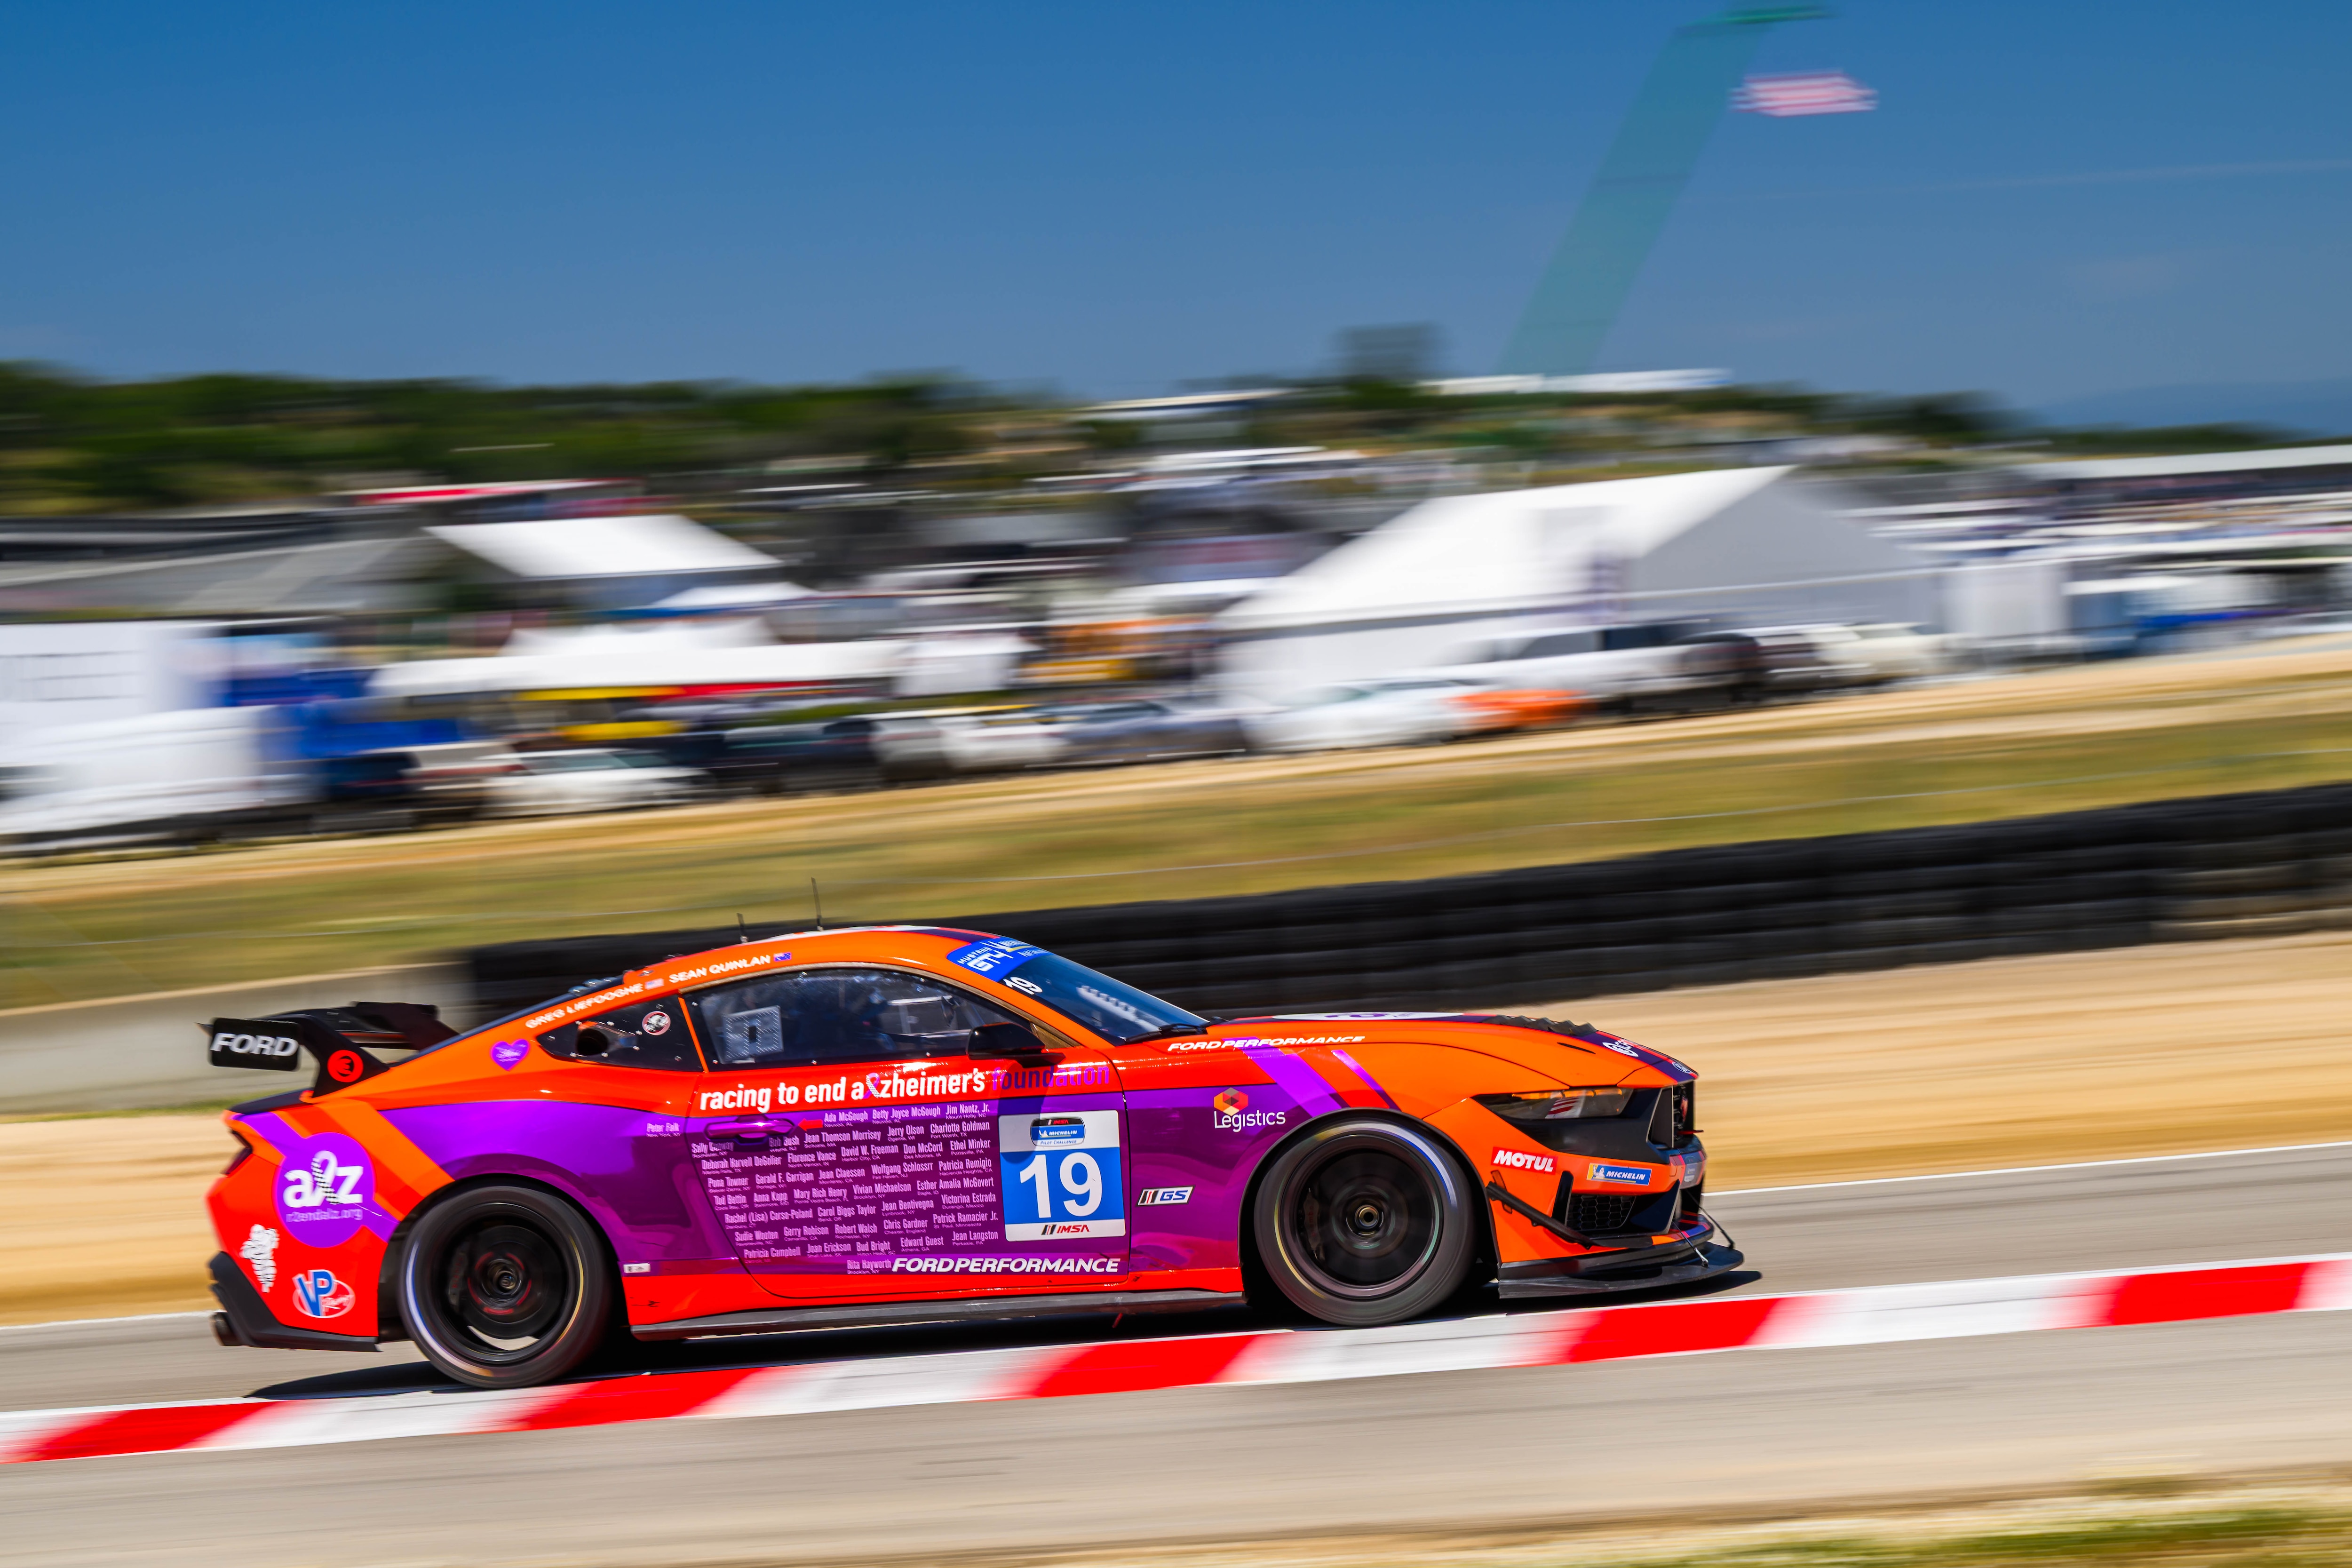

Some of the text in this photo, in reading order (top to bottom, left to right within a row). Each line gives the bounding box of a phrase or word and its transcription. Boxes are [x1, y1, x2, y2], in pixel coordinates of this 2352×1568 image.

[967, 949, 1014, 972] GT4
[669, 955, 771, 983] SEAN QUINLAN
[1003, 976, 1043, 995] 19
[210, 1032, 299, 1057] FORD
[700, 1083, 771, 1113] racing
[778, 1082, 799, 1105] to
[805, 1076, 846, 1102] end
[992, 1062, 1109, 1090] foundation
[873, 1105, 941, 1120] Betty Joyce McGough
[946, 1102, 990, 1115] Jim Nantz, Jr.
[824, 1110, 868, 1122] Ada McGough
[887, 1124, 924, 1138] Jerry Olson
[930, 1121, 990, 1134] Charlotte Goldman
[783, 1135, 800, 1146] Bush
[804, 1133, 820, 1143] Jean
[821, 1131, 851, 1142] Thomson
[691, 1142, 708, 1154] Sally
[903, 1141, 943, 1154] Don McCord
[950, 1138, 991, 1151] Ethel Minker
[787, 1151, 837, 1163] Florence Vance
[841, 1145, 899, 1157] David W. Freeman
[701, 1158, 729, 1170] Deborah
[938, 1157, 992, 1171] Patricia Remigio
[1493, 1150, 1554, 1173] MOTUL
[818, 1169, 834, 1180] Jean
[871, 1164, 901, 1175] Wolfgang
[1606, 1170, 1645, 1181] MICHELIN
[755, 1173, 777, 1184] Gerald
[916, 1177, 994, 1191] Esther Amalia McGovert
[852, 1182, 912, 1194] Vivian Michaelson
[1020, 1152, 1103, 1218] 19
[753, 1193, 770, 1203] Anna
[793, 1187, 847, 1200] Mary Rich Henry
[941, 1192, 996, 1204] Victorina Estrada
[1159, 1190, 1188, 1202] GS
[818, 1204, 877, 1218] Carol Biggs Taylor
[881, 1199, 934, 1212] Jean Bentivegna
[724, 1213, 747, 1224] Rachel
[748, 1211, 769, 1224] (Lisa)
[933, 1210, 998, 1223] Patrick Ramacier Jr.
[834, 1223, 877, 1234] Robert Walsh
[883, 1218, 929, 1230] Chris Gardner
[1057, 1224, 1090, 1234] IMSA
[734, 1231, 753, 1242] Sudie
[900, 1236, 944, 1247] Edward Guest
[952, 1230, 999, 1242] Jean Langston
[744, 1246, 801, 1258] Patricia Campbell
[824, 1242, 852, 1252] Erickson
[856, 1241, 891, 1252] Bud Bright
[847, 1258, 892, 1270] Rita Hayworth
[294, 1269, 336, 1317] VP
